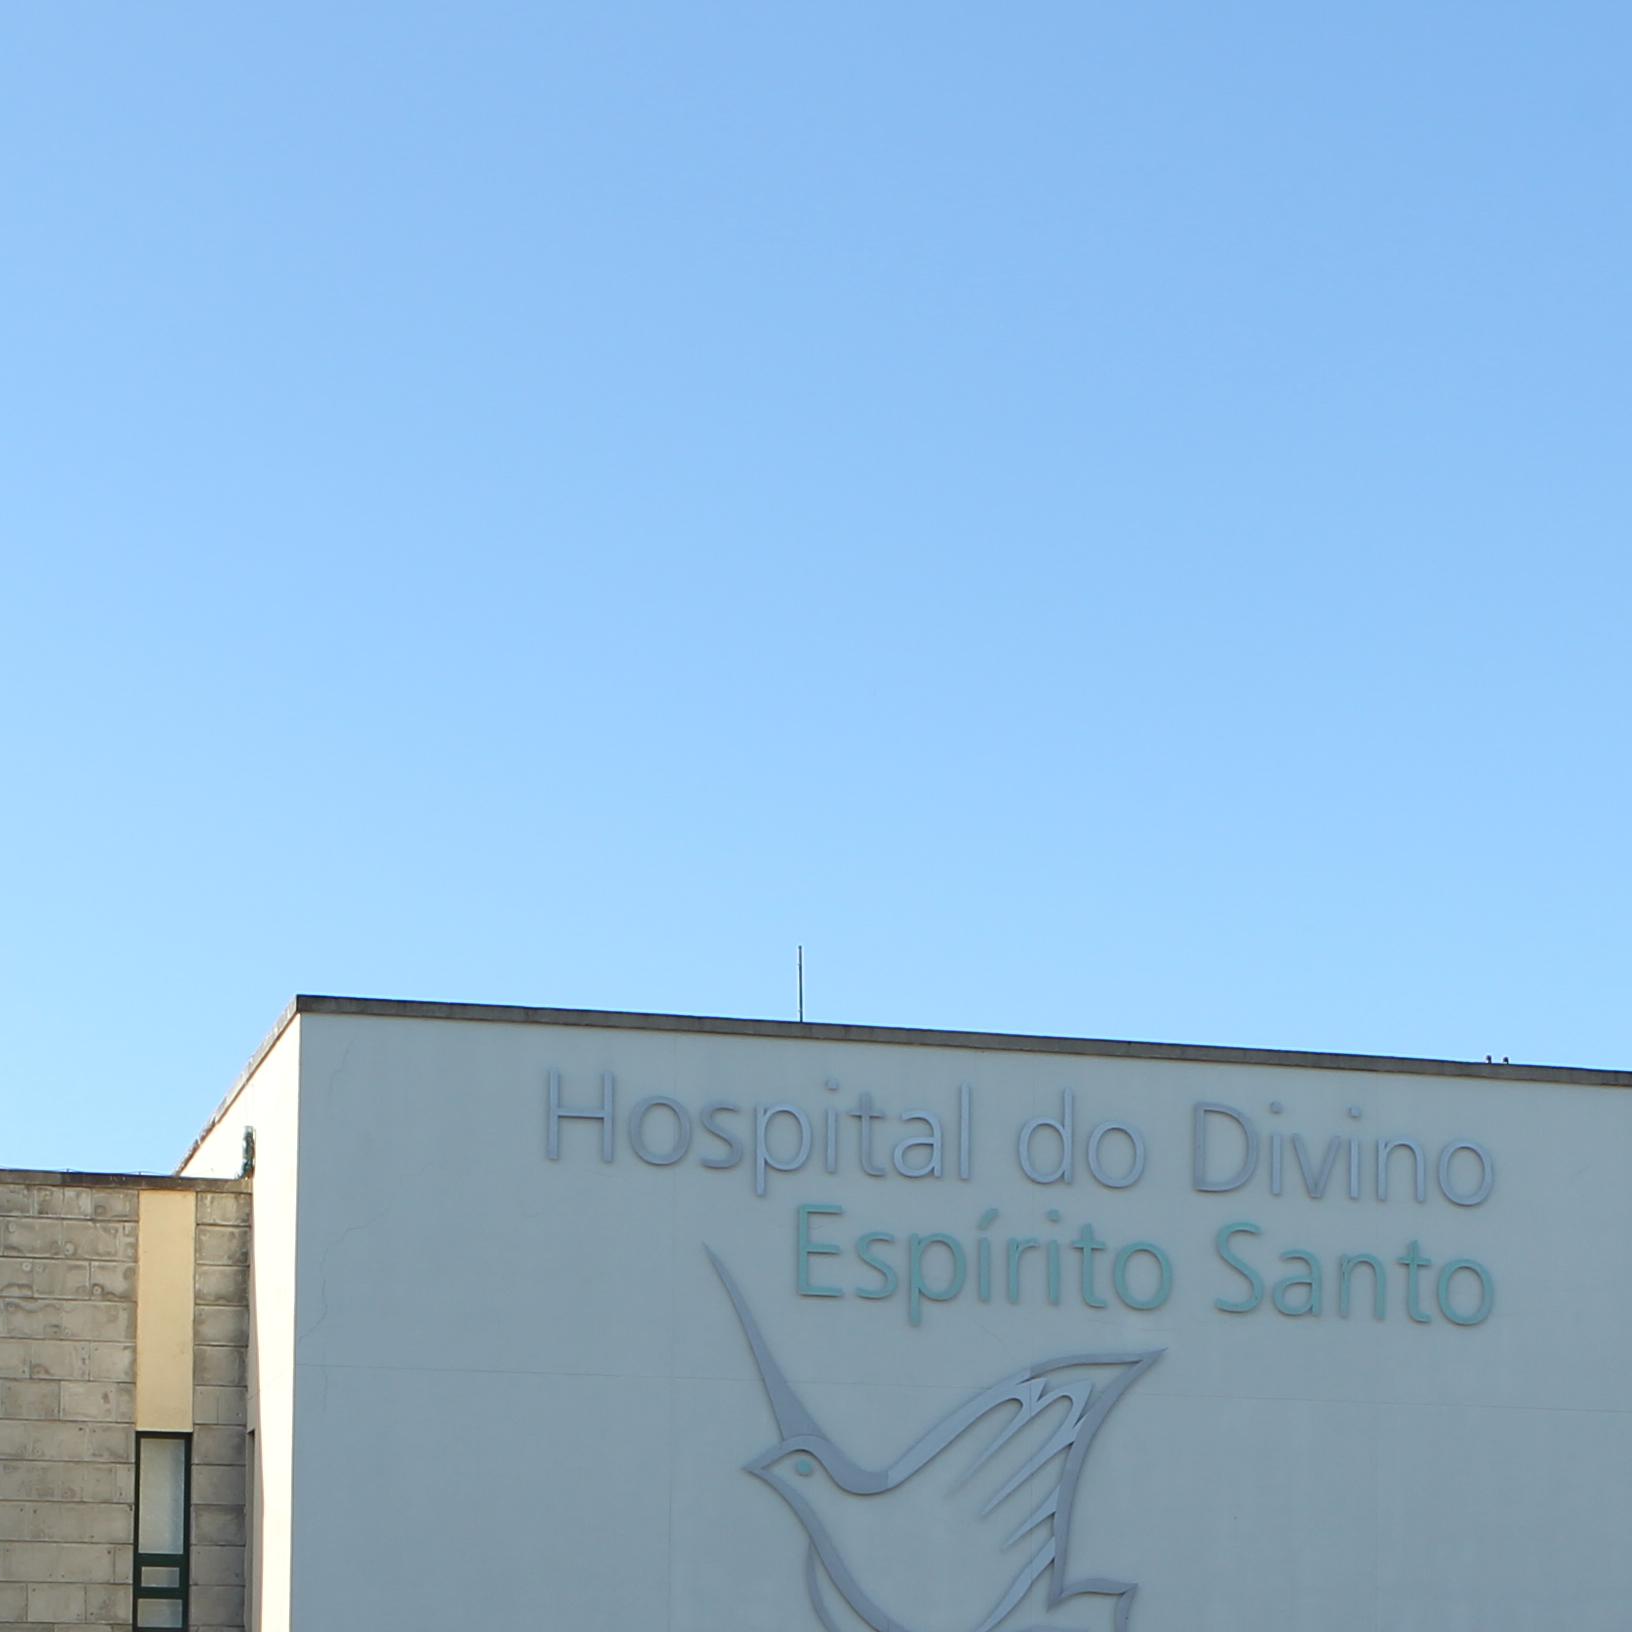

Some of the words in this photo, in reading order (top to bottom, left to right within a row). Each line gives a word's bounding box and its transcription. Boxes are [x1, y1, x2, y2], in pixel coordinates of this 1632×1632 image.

[543, 1067, 972, 1197] Hospital
[1016, 1088, 1146, 1189] do
[1191, 1100, 1495, 1207] Divino
[794, 1203, 1171, 1327] Espírito
[1212, 1220, 1496, 1327] Santo
